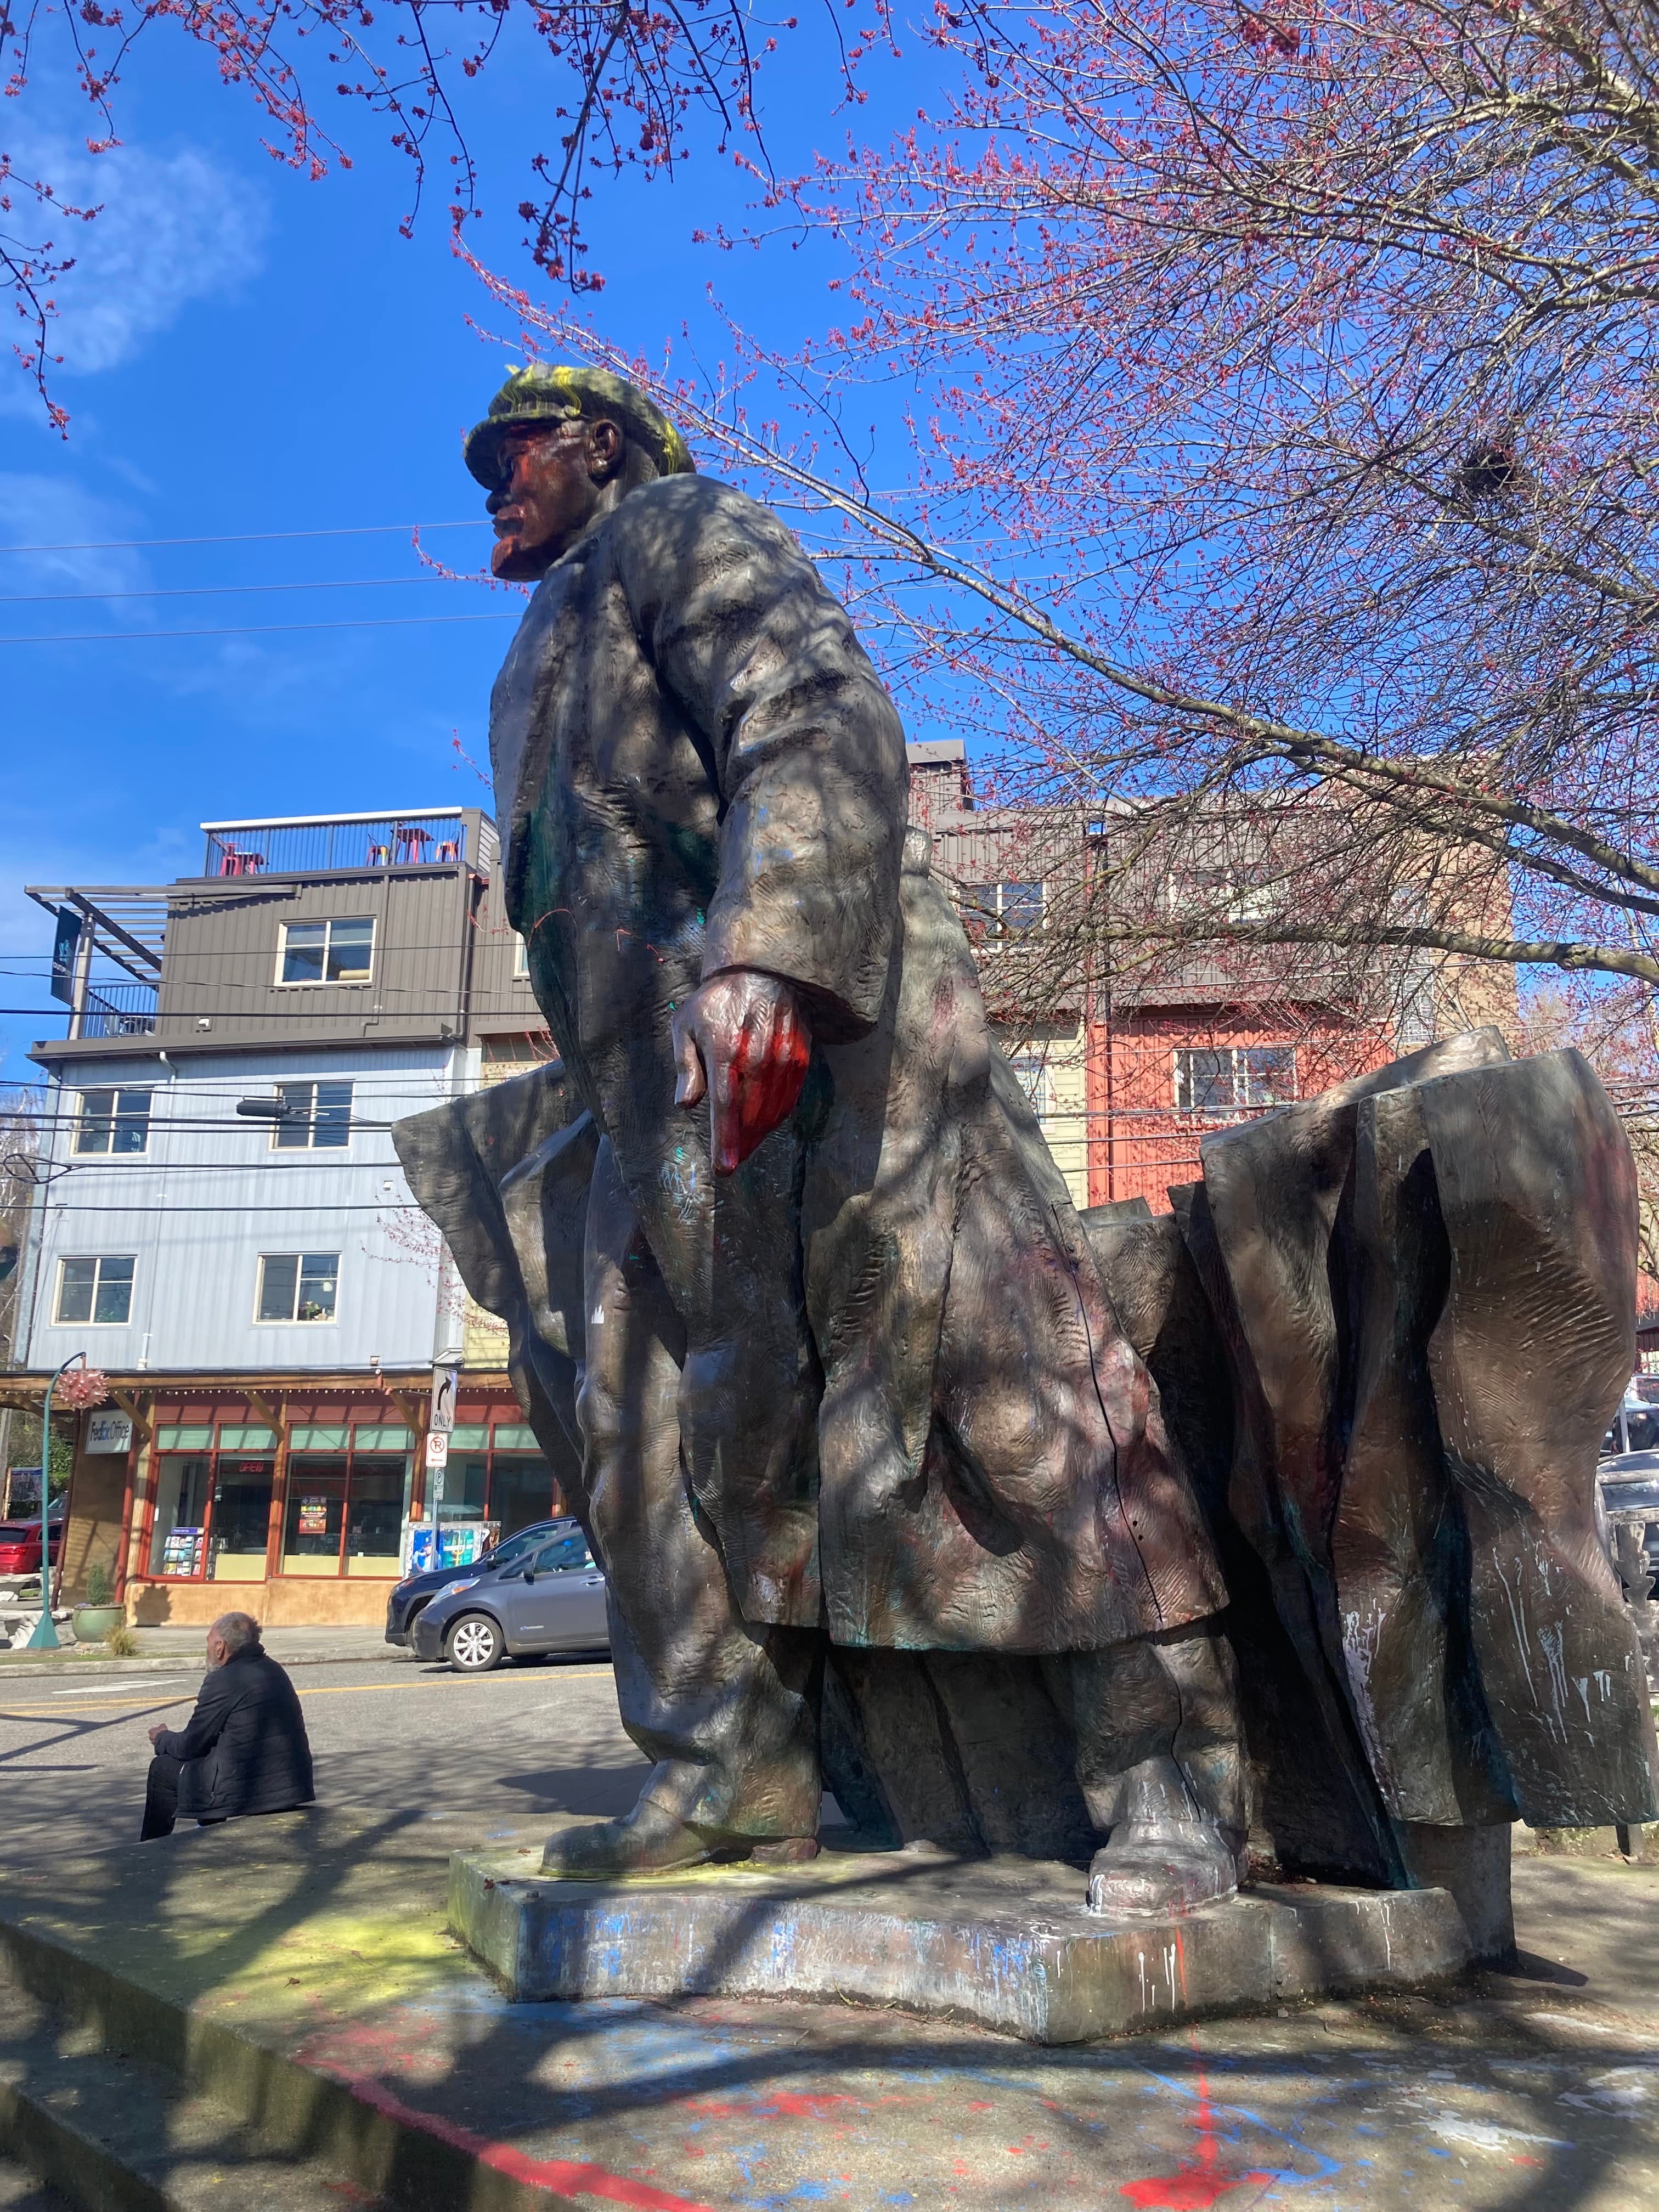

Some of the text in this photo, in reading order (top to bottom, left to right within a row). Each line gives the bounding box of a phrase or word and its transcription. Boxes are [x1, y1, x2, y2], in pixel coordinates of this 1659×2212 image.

[435, 1414, 452, 1427] ONLY
[90, 1420, 129, 1441] FedEx Office
[240, 1462, 263, 1472] OPEN
